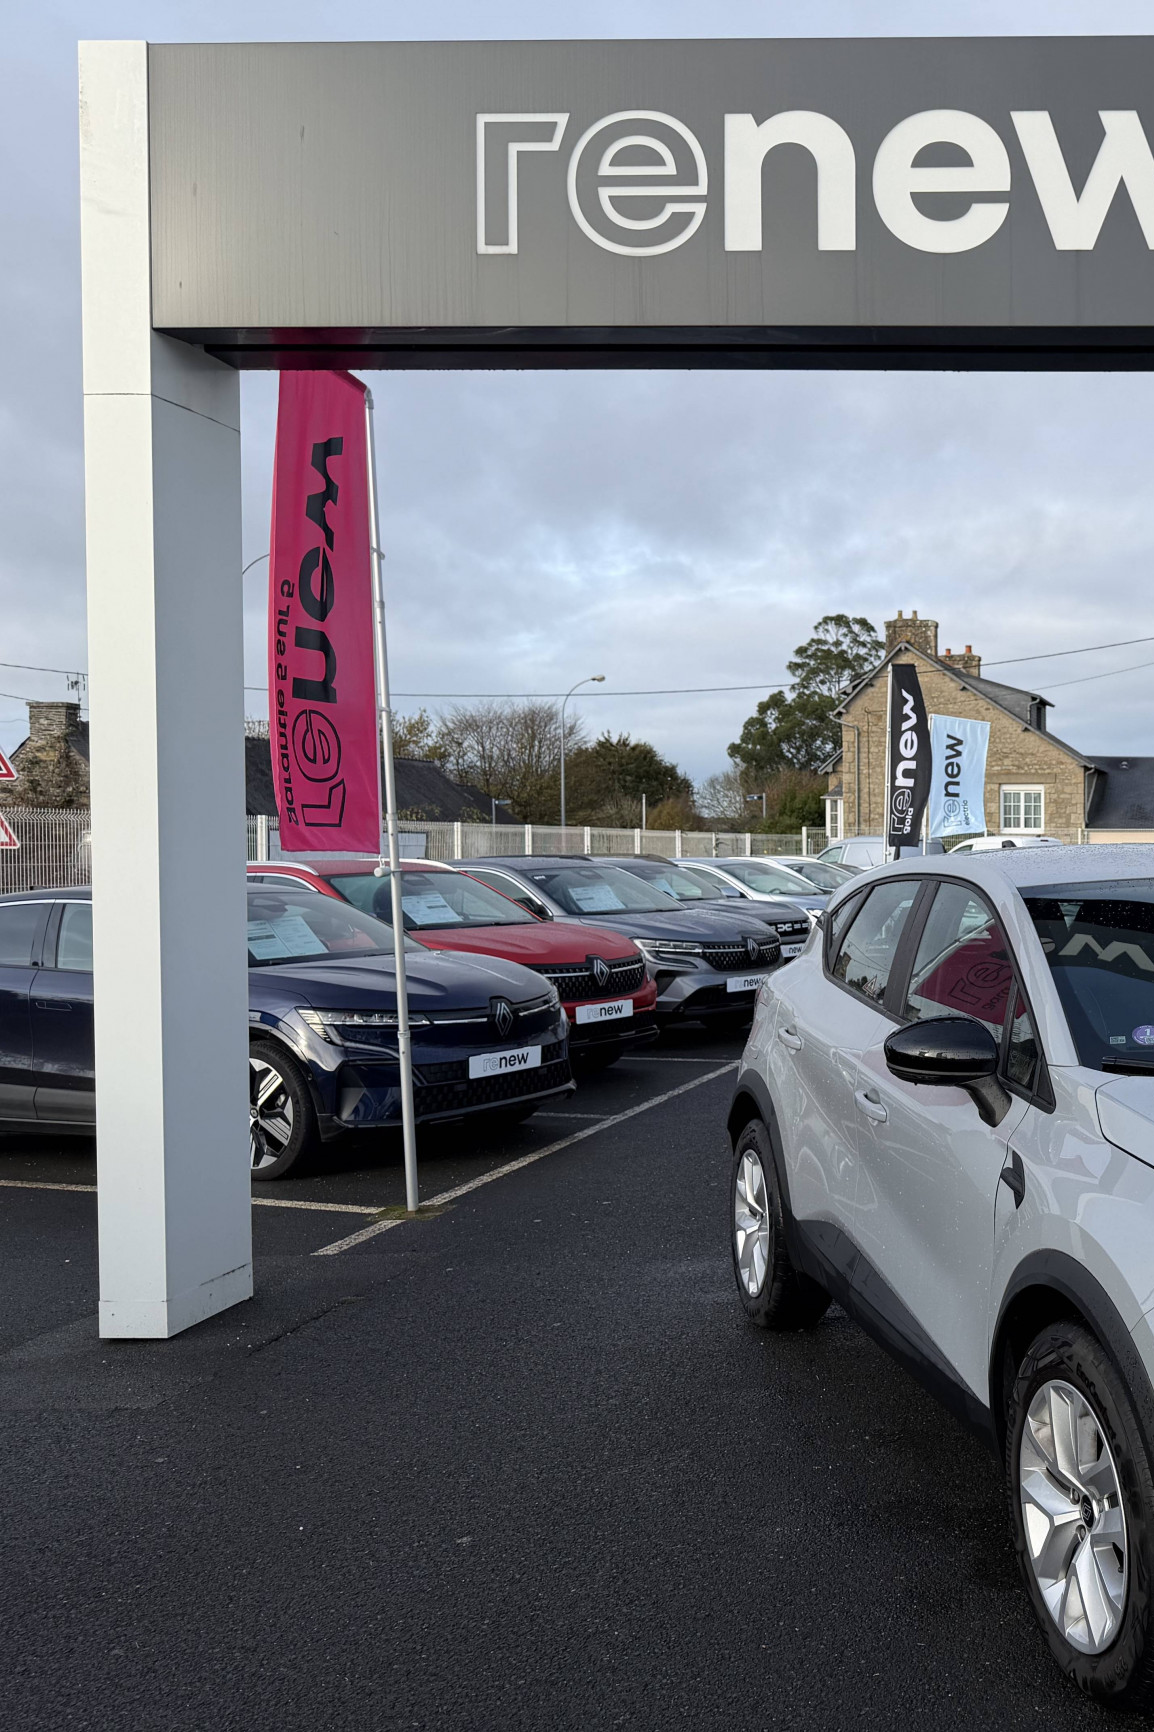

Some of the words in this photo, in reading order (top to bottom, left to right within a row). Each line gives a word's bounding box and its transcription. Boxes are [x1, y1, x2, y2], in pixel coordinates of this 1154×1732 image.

[890, 688, 919, 835] renew
[943, 733, 964, 828] renew
[903, 807, 914, 834] gold
[587, 1003, 624, 1020] renew
[482, 1051, 529, 1072] renew
